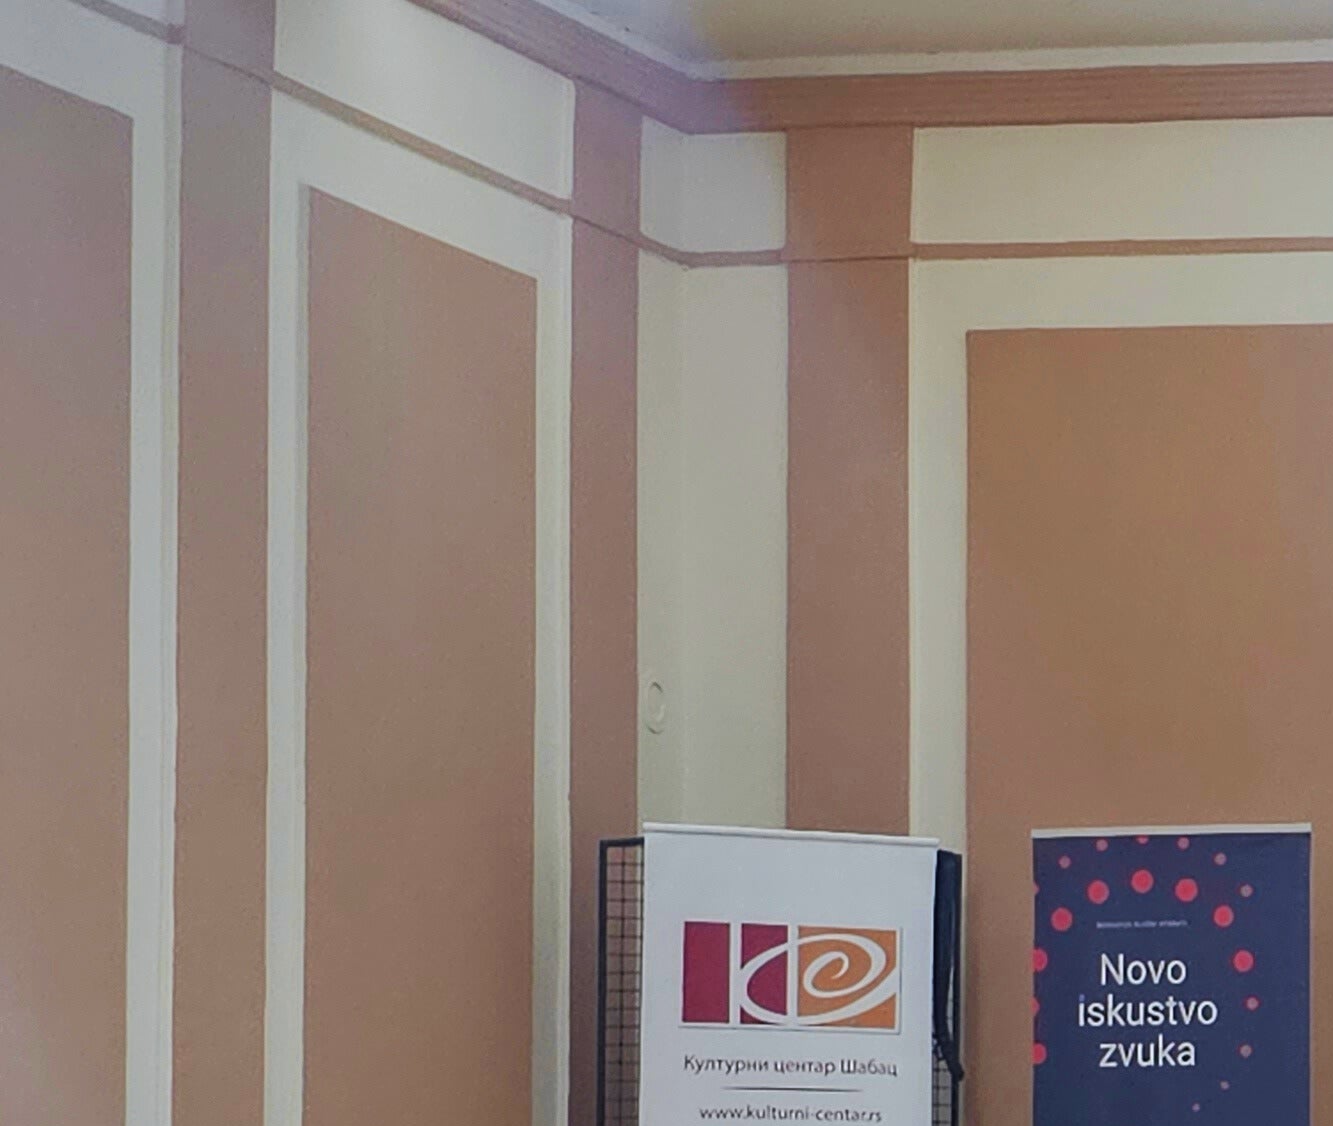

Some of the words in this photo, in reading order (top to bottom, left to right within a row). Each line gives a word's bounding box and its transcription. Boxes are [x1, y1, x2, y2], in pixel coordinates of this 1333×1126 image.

[1100, 953, 1188, 986] Novo
[1077, 993, 1219, 1027] iskustvo
[683, 1054, 769, 1075] Културни
[773, 1058, 837, 1077] центар
[839, 1057, 898, 1077] Шабац
[1098, 1033, 1196, 1067] zvuka
[699, 1104, 882, 1123] www.kulturni-centar.rs
